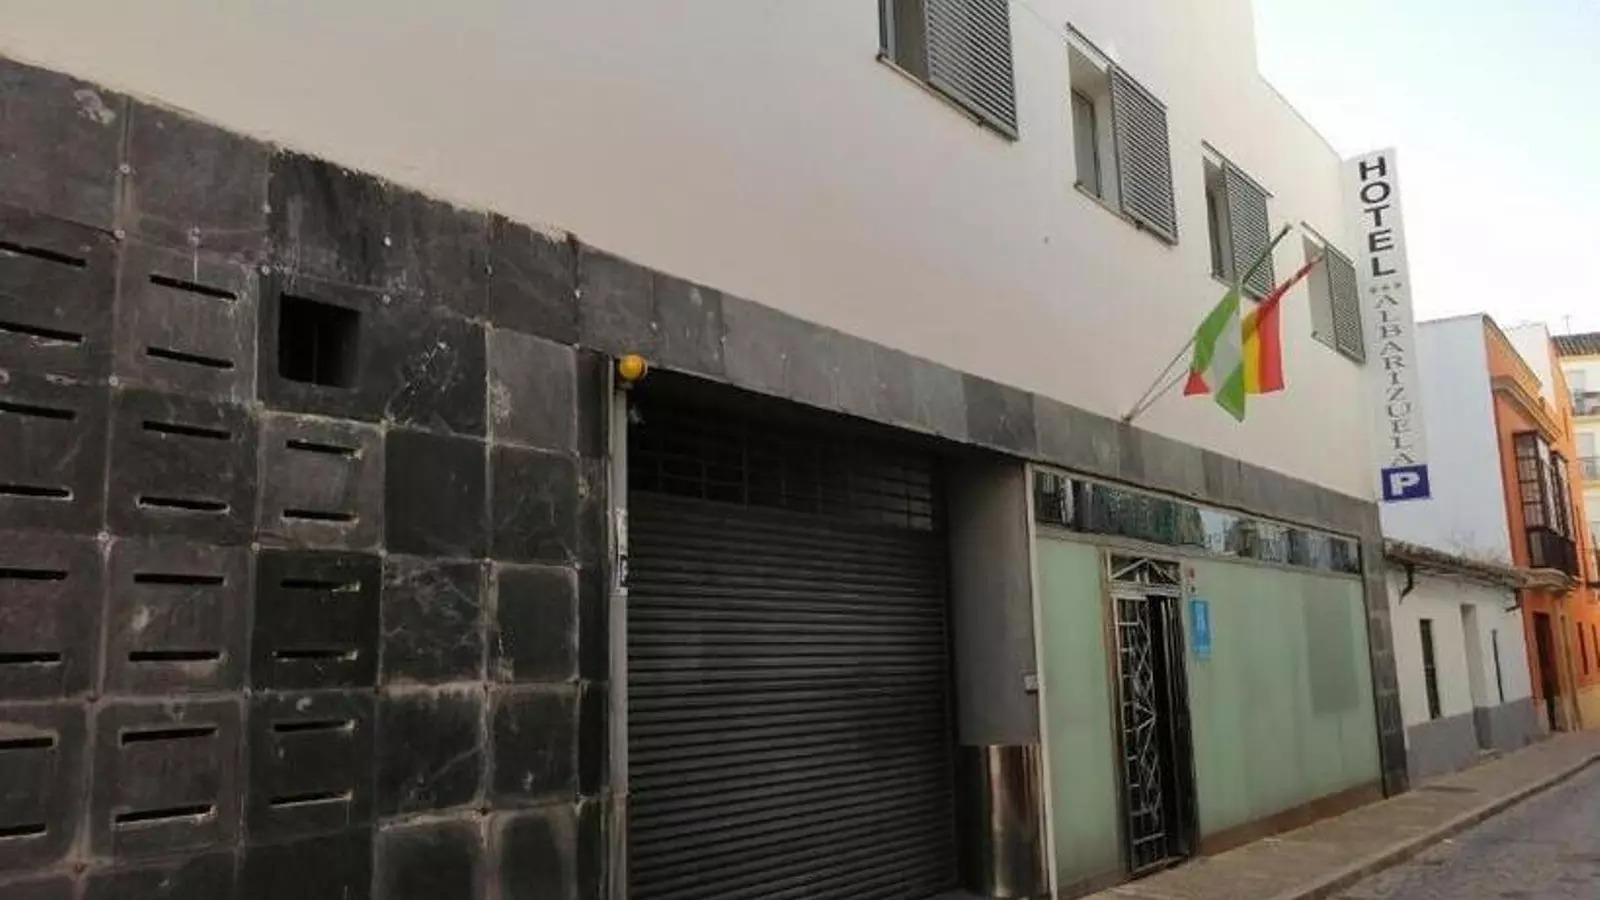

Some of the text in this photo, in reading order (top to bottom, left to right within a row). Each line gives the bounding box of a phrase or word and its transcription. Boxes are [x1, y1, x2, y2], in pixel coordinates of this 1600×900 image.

[1359, 156, 1414, 465] HOTEL ALBARIZUELA
[1389, 471, 1420, 497] P
